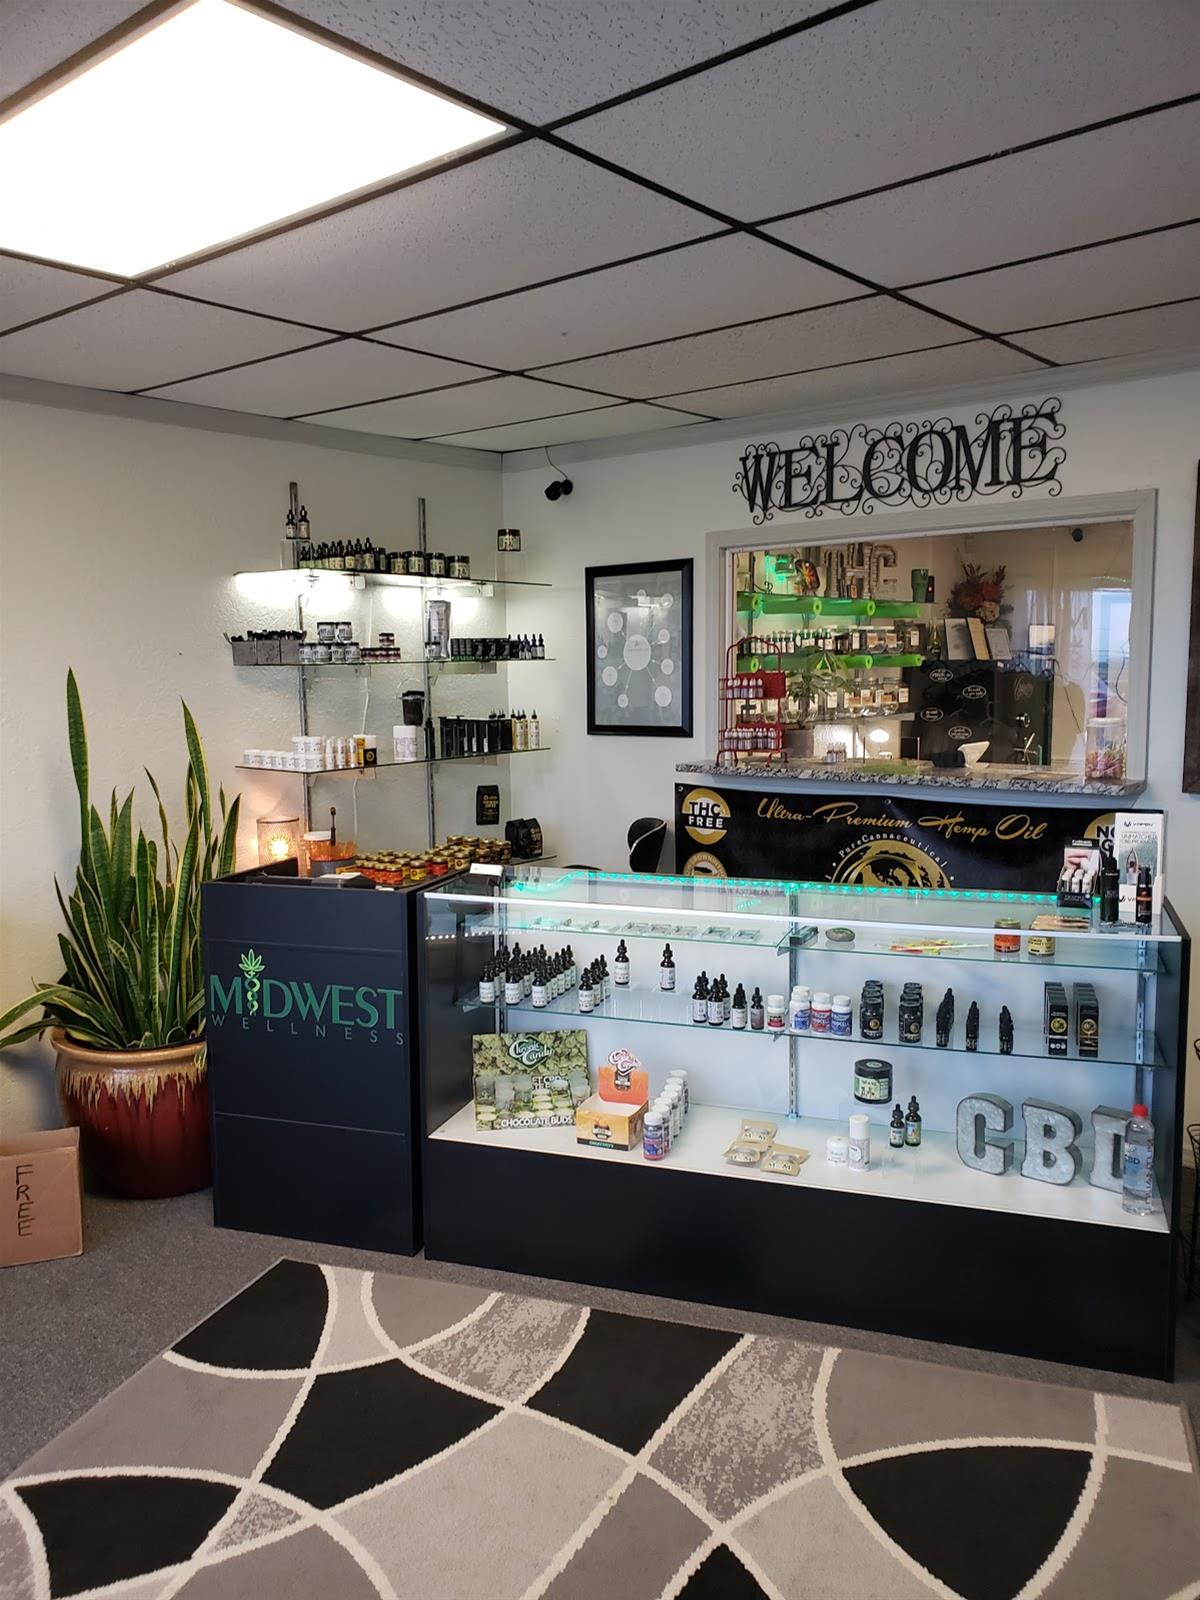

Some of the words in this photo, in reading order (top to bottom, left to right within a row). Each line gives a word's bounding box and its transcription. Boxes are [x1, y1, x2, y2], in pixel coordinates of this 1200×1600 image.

[735, 402, 1065, 519] WELCOME
[688, 816, 723, 829] FREE
[689, 801, 722, 816] THC
[756, 797, 914, 829] Ultra-Premium
[917, 810, 991, 841] Hemp
[995, 813, 1049, 841] Oil
[209, 968, 404, 1030] MIDWEST
[211, 1013, 405, 1046] WELLNESS
[501, 1117, 549, 1128] CHOCOLATE
[550, 1115, 573, 1125] BUDS
[15, 1164, 35, 1237] FREE
